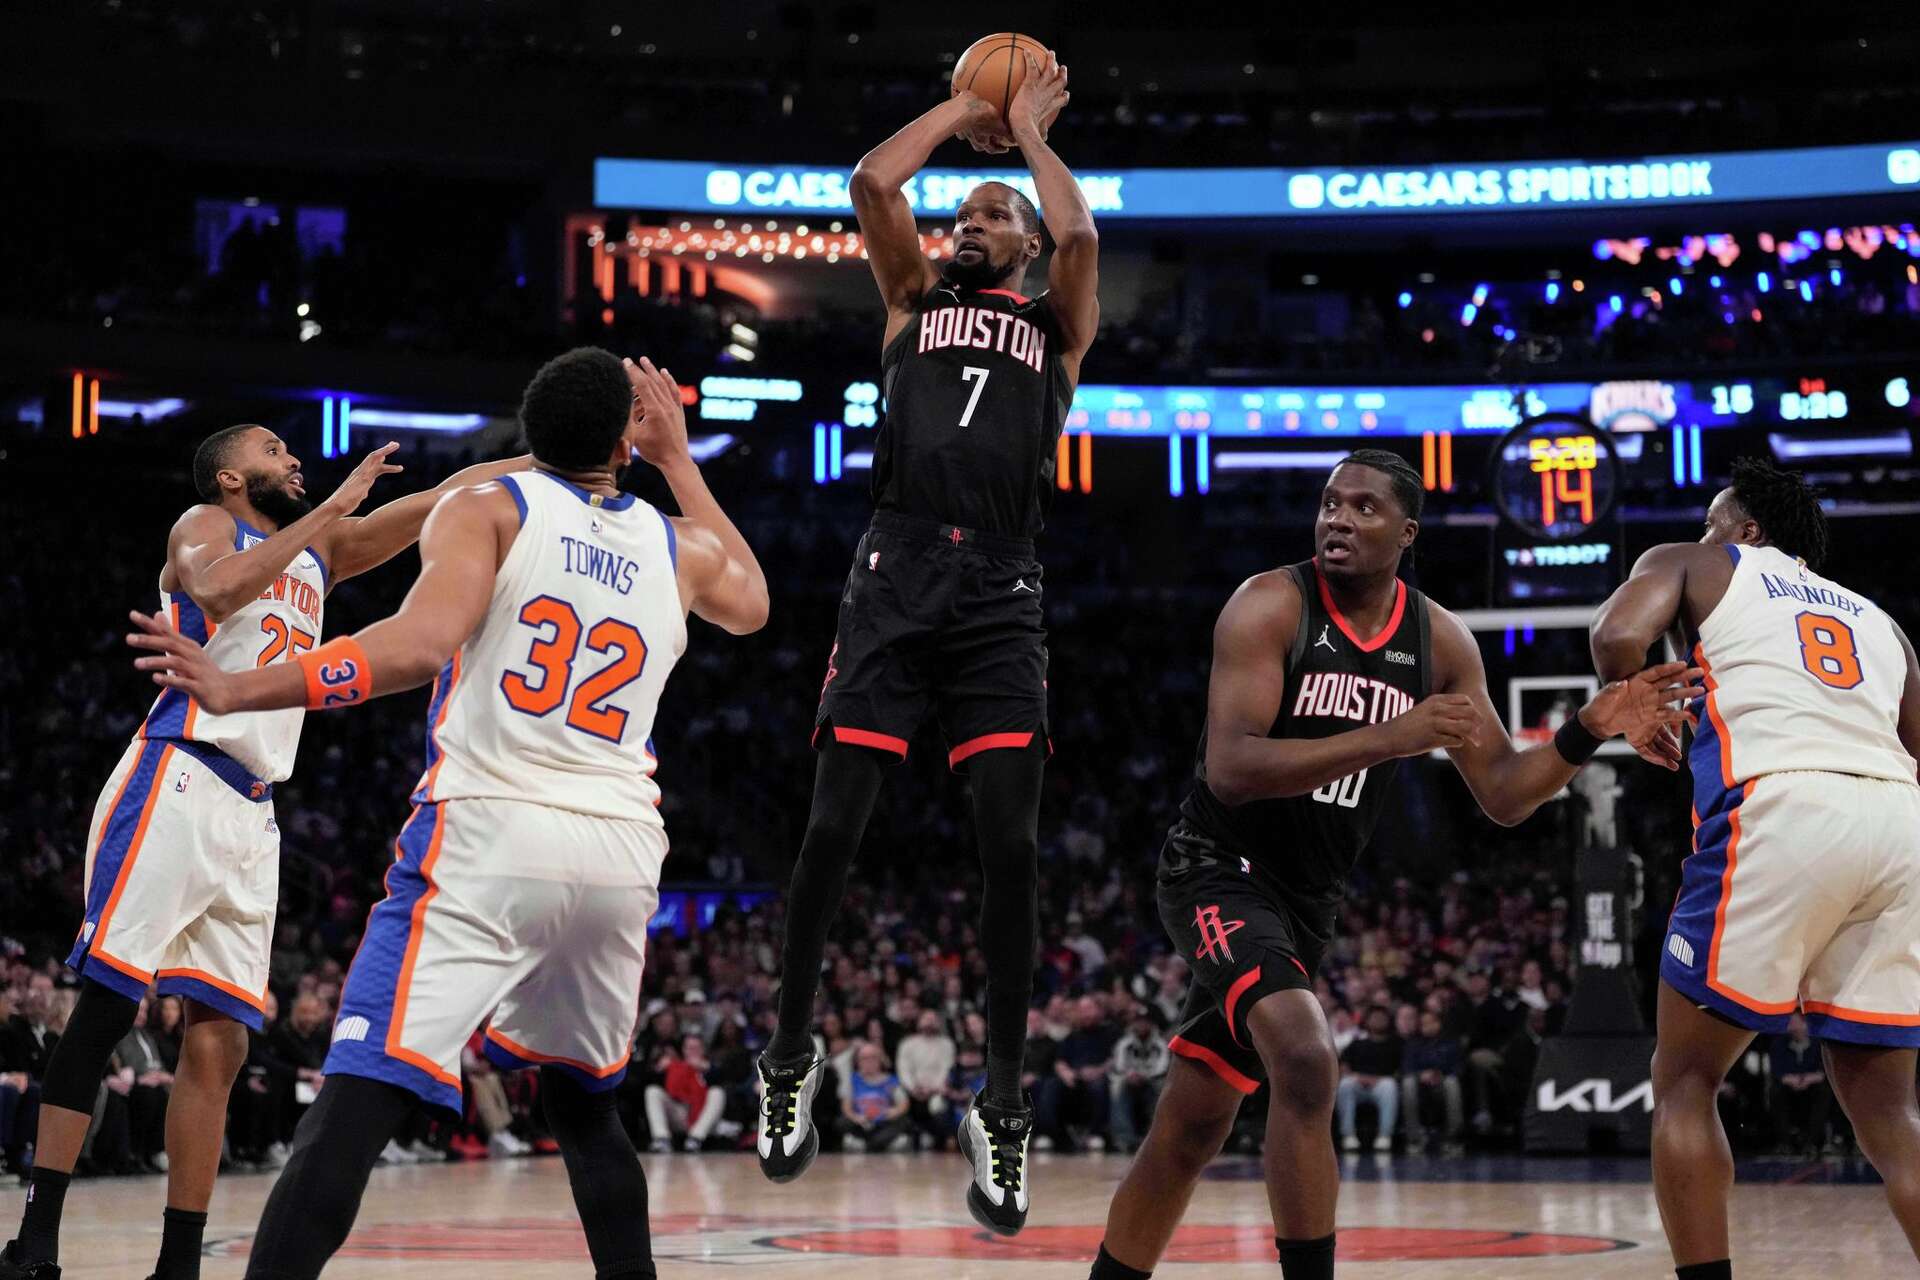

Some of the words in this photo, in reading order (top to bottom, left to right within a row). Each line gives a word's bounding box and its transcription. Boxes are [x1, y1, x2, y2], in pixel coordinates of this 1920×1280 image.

[1326, 171, 1503, 207] CAESARS
[1507, 161, 1713, 204] SPORTSBOOK
[918, 306, 1047, 375] HOUSTON
[958, 366, 990, 428] 7
[1529, 436, 1598, 473] 5:28
[1540, 468, 1594, 527] 14
[560, 536, 639, 595] TOWNS
[1760, 572, 1865, 618] ANUNOBY
[499, 593, 649, 745] 32
[1794, 610, 1865, 690] 8
